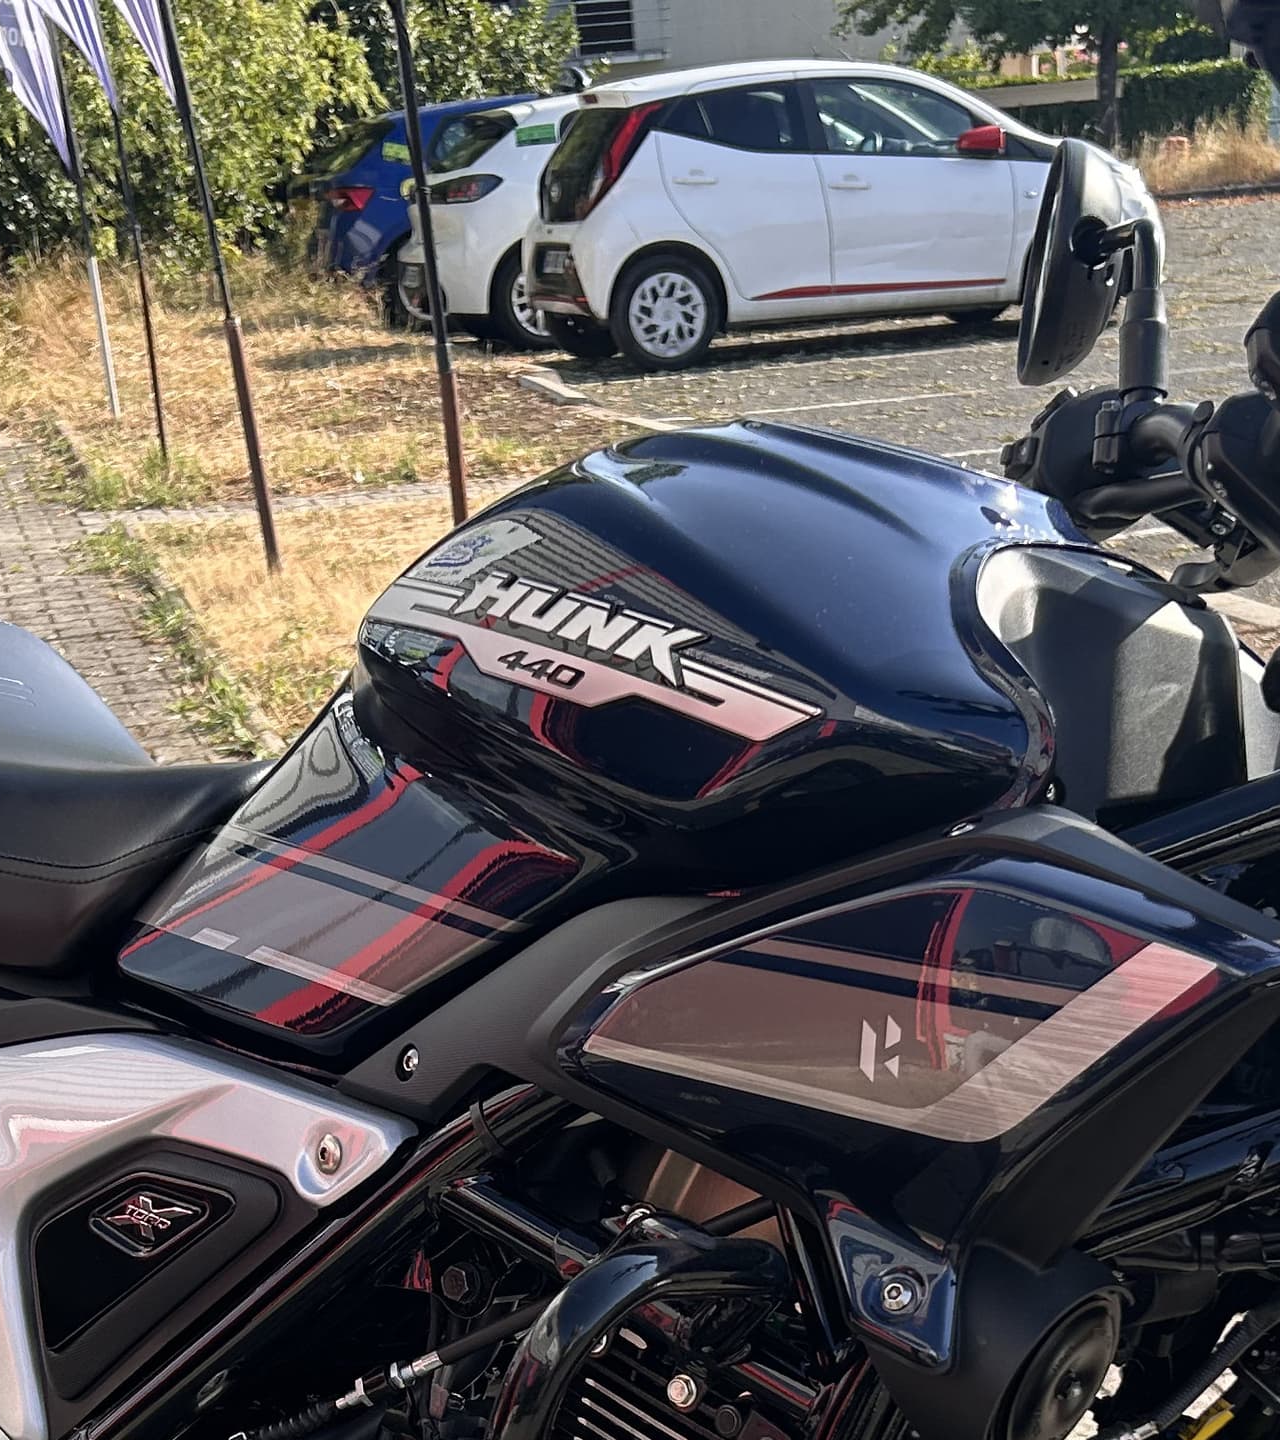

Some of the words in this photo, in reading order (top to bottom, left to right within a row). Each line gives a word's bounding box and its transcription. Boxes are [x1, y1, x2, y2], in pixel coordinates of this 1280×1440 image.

[451, 570, 711, 689] HUNK
[497, 650, 586, 691] 440
[126, 1204, 172, 1230] TORQ
